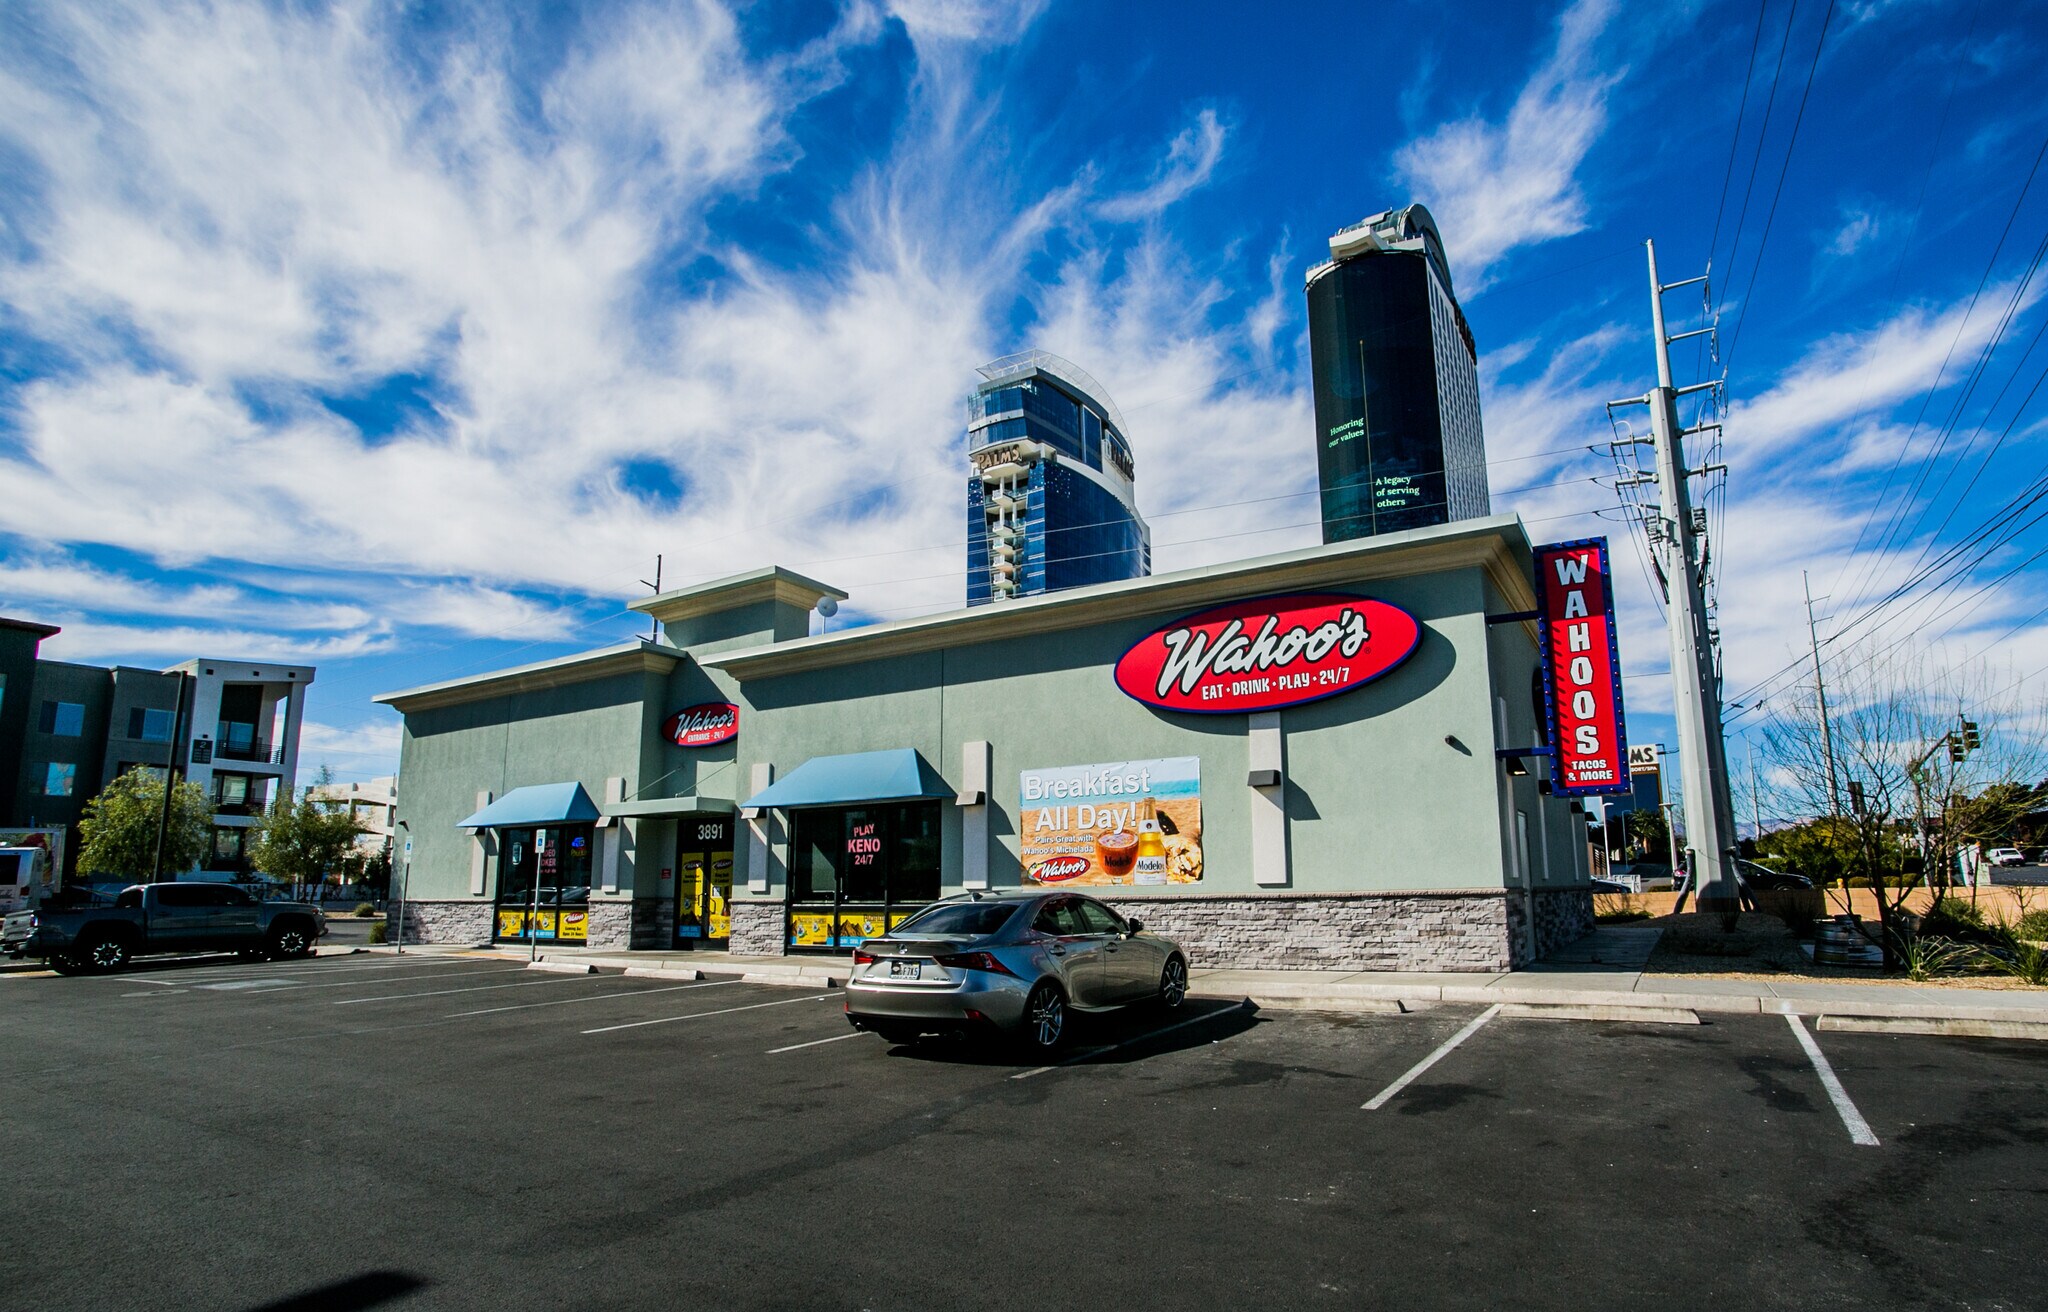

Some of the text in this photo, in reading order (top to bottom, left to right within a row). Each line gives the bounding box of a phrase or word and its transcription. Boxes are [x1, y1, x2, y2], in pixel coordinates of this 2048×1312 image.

[1330, 417, 1364, 436] Honoring
[1328, 429, 1365, 448] our values
[976, 449, 1020, 469] PALMS
[1375, 476, 1412, 486] A legacy
[1376, 486, 1420, 497] of serving
[1377, 499, 1406, 508] others
[1156, 608, 1370, 699] Wahoo's
[1555, 554, 1600, 755] WAHOOS
[1202, 667, 1350, 701] EAT DRINK PLAY 24/7
[674, 710, 735, 740] Wahoo's
[199, 741, 207, 749] 2
[1571, 759, 1607, 770] TACOS
[1567, 769, 1613, 782] & MORE
[1025, 767, 1151, 800] Breakfast
[1035, 801, 1137, 835] All Day!
[697, 823, 723, 840] 3891
[853, 823, 875, 837] PLAY
[848, 838, 881, 853] KENO
[1055, 834, 1076, 843] Great
[1078, 833, 1094, 842] with
[1056, 845, 1094, 854] Michelada
[854, 854, 874, 865] 24/7
[1138, 860, 1163, 871] Modelo
[1041, 859, 1087, 879] Wahoo's
